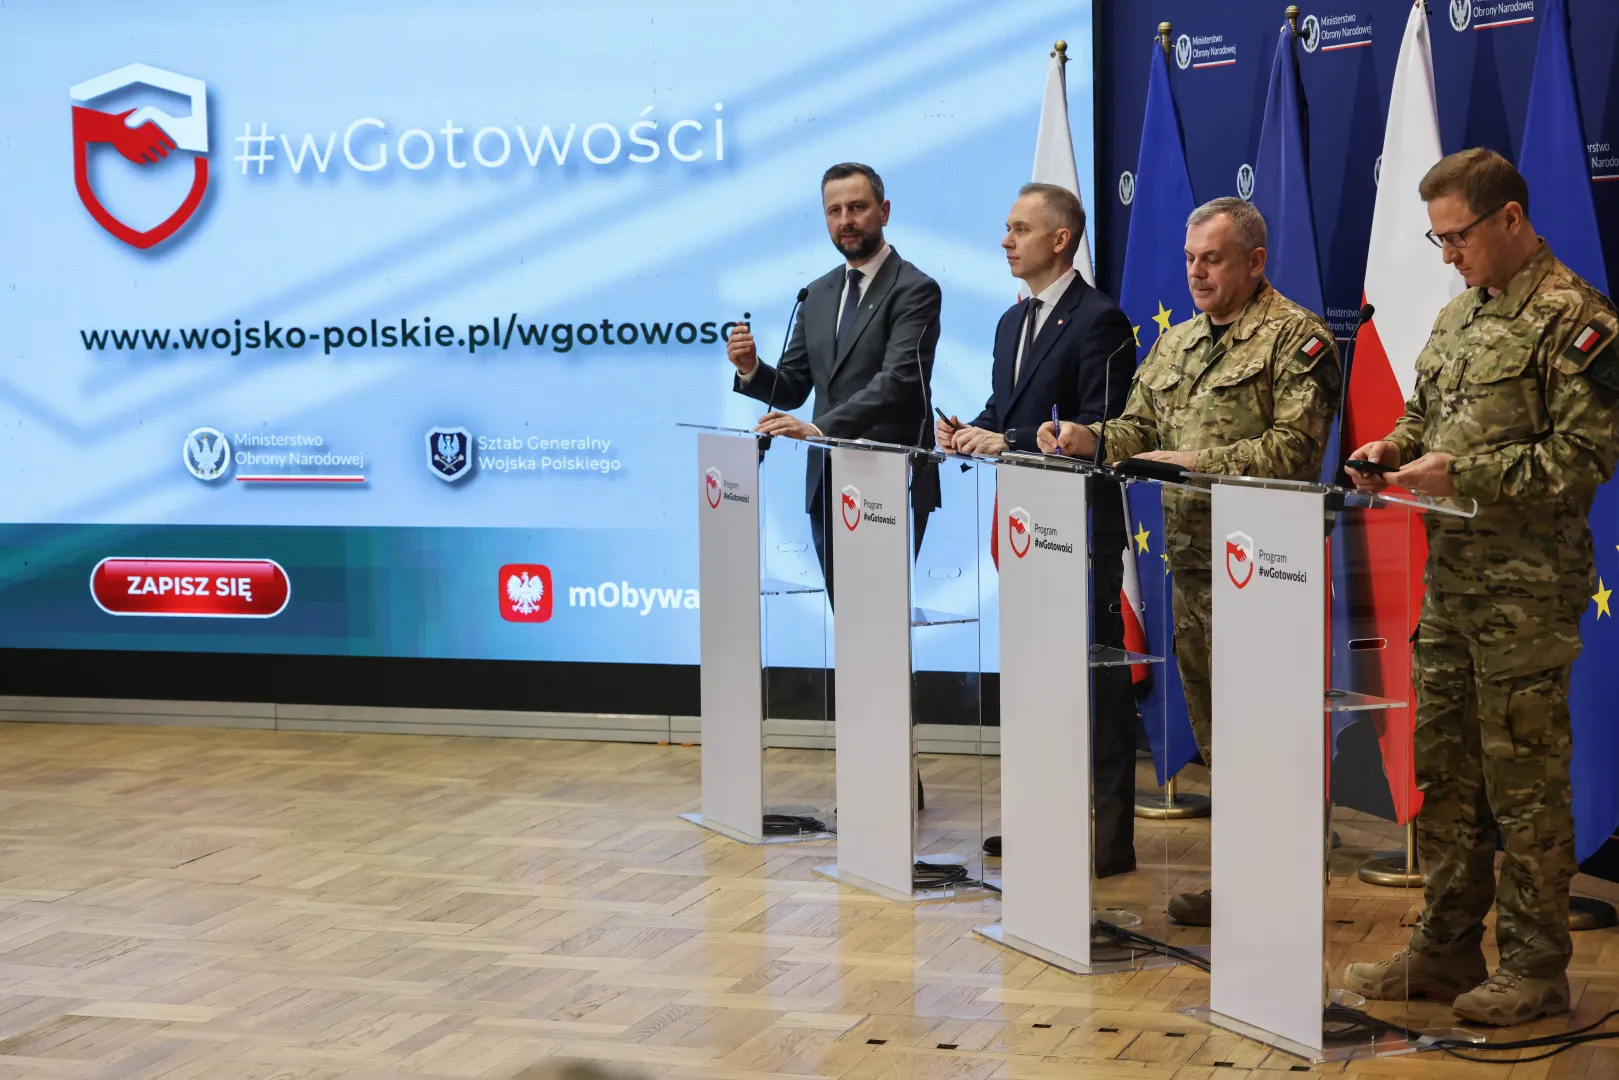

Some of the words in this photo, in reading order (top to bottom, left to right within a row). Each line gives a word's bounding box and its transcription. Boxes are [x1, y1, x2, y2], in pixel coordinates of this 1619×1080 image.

[1473, 7, 1497, 18] Obrony
[1498, 0, 1534, 13] Narodowej
[1321, 14, 1356, 26] Ministerstwo
[1321, 30, 1341, 40] Obrony
[1342, 23, 1372, 37] Narodowej
[1192, 35, 1223, 45] Ministerstwo
[1192, 48, 1210, 58] Obrony
[1210, 44, 1236, 56] Narodowej
[233, 101, 726, 176] #wGotowości
[234, 432, 323, 446] Ministerstwo
[478, 435, 523, 450] Sztab
[527, 435, 611, 453] Generalny
[235, 451, 286, 468] Obrony
[289, 451, 364, 468] Narodowej
[478, 456, 536, 473] Wojska
[541, 456, 621, 474] Polskiego
[724, 480, 740, 490] Program
[724, 492, 750, 503] #wGotowości
[864, 499, 882, 511] Program
[864, 513, 896, 526] #wGotowości
[1034, 523, 1058, 536] Program
[1034, 538, 1073, 554] #wGotowości
[1258, 549, 1287, 564] Program
[1258, 566, 1307, 583] #wGotowości
[127, 576, 210, 596] ZAPISZ
[216, 577, 253, 602] SIĘ
[568, 580, 700, 616] mObywa
